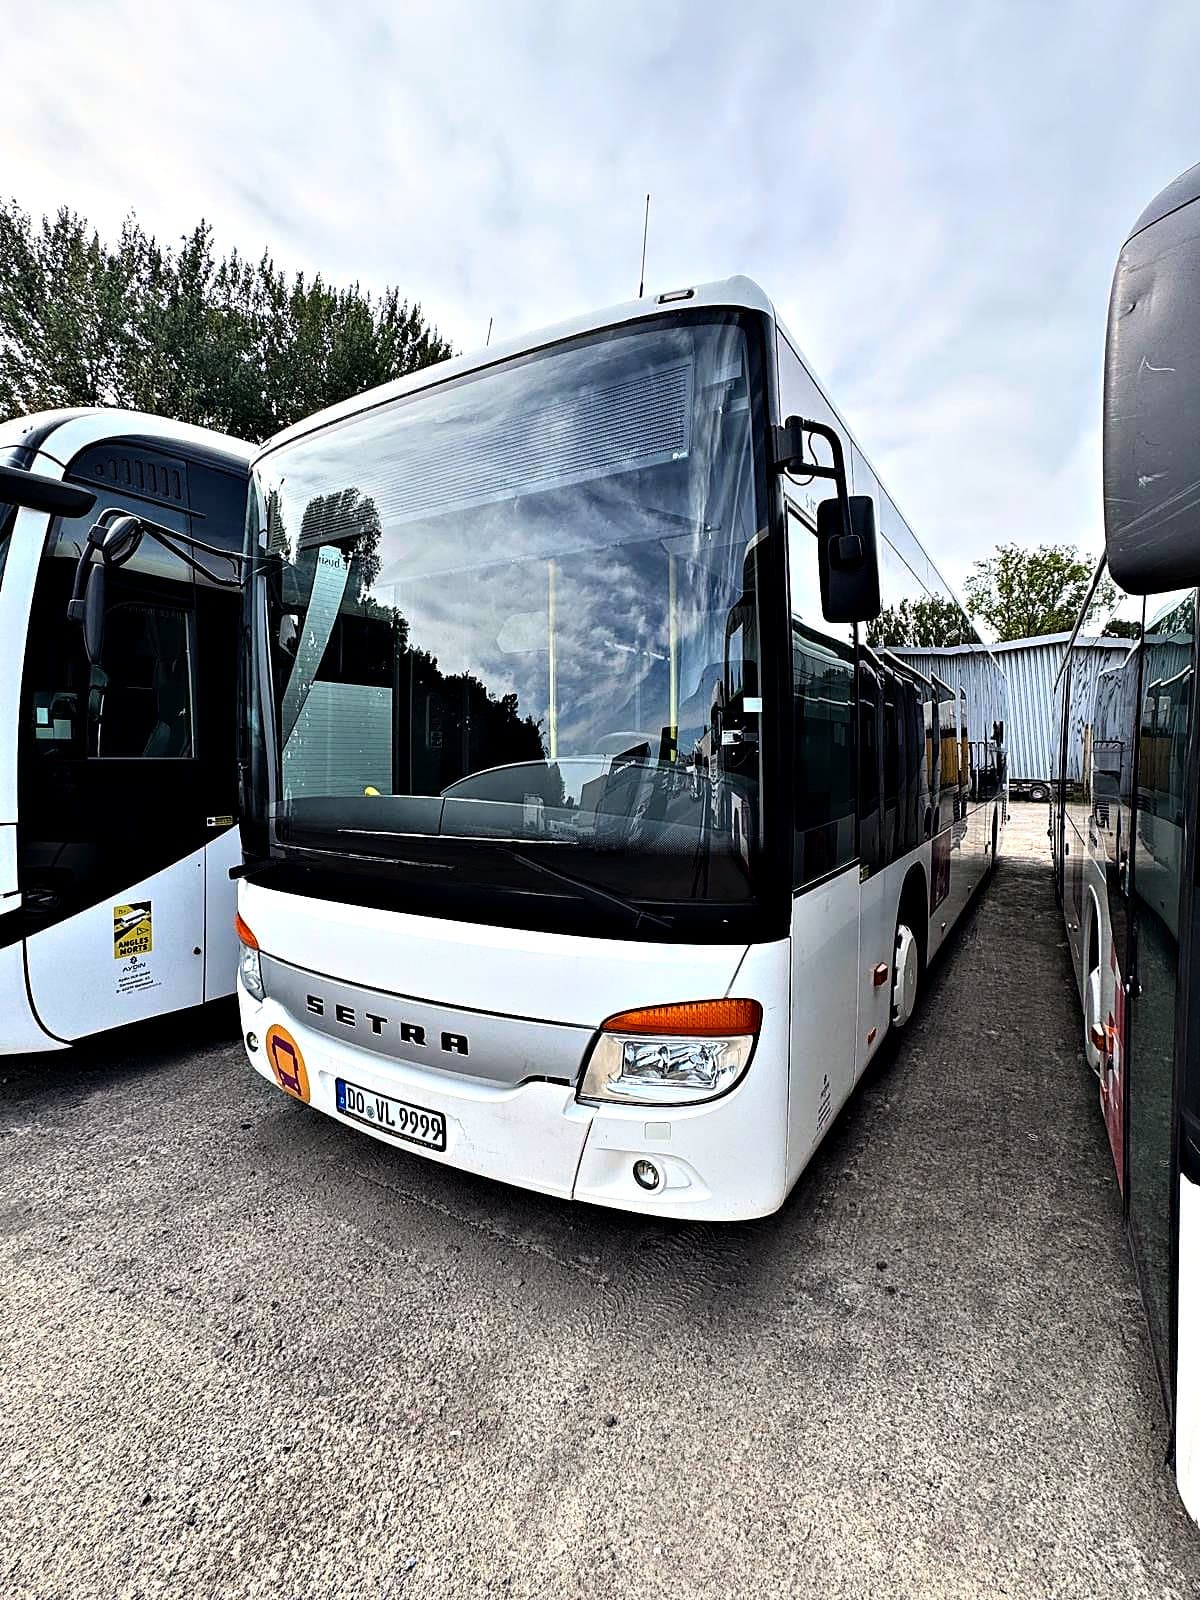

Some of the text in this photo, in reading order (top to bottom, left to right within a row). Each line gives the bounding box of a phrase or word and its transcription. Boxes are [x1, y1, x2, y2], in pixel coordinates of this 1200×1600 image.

[119, 937, 149, 948] ANGLES
[120, 944, 147, 955] MORTS
[306, 994, 469, 1056] SETRA
[346, 1087, 365, 1114] DO
[375, 1098, 395, 1126] VL
[399, 1107, 441, 1141] 9999
